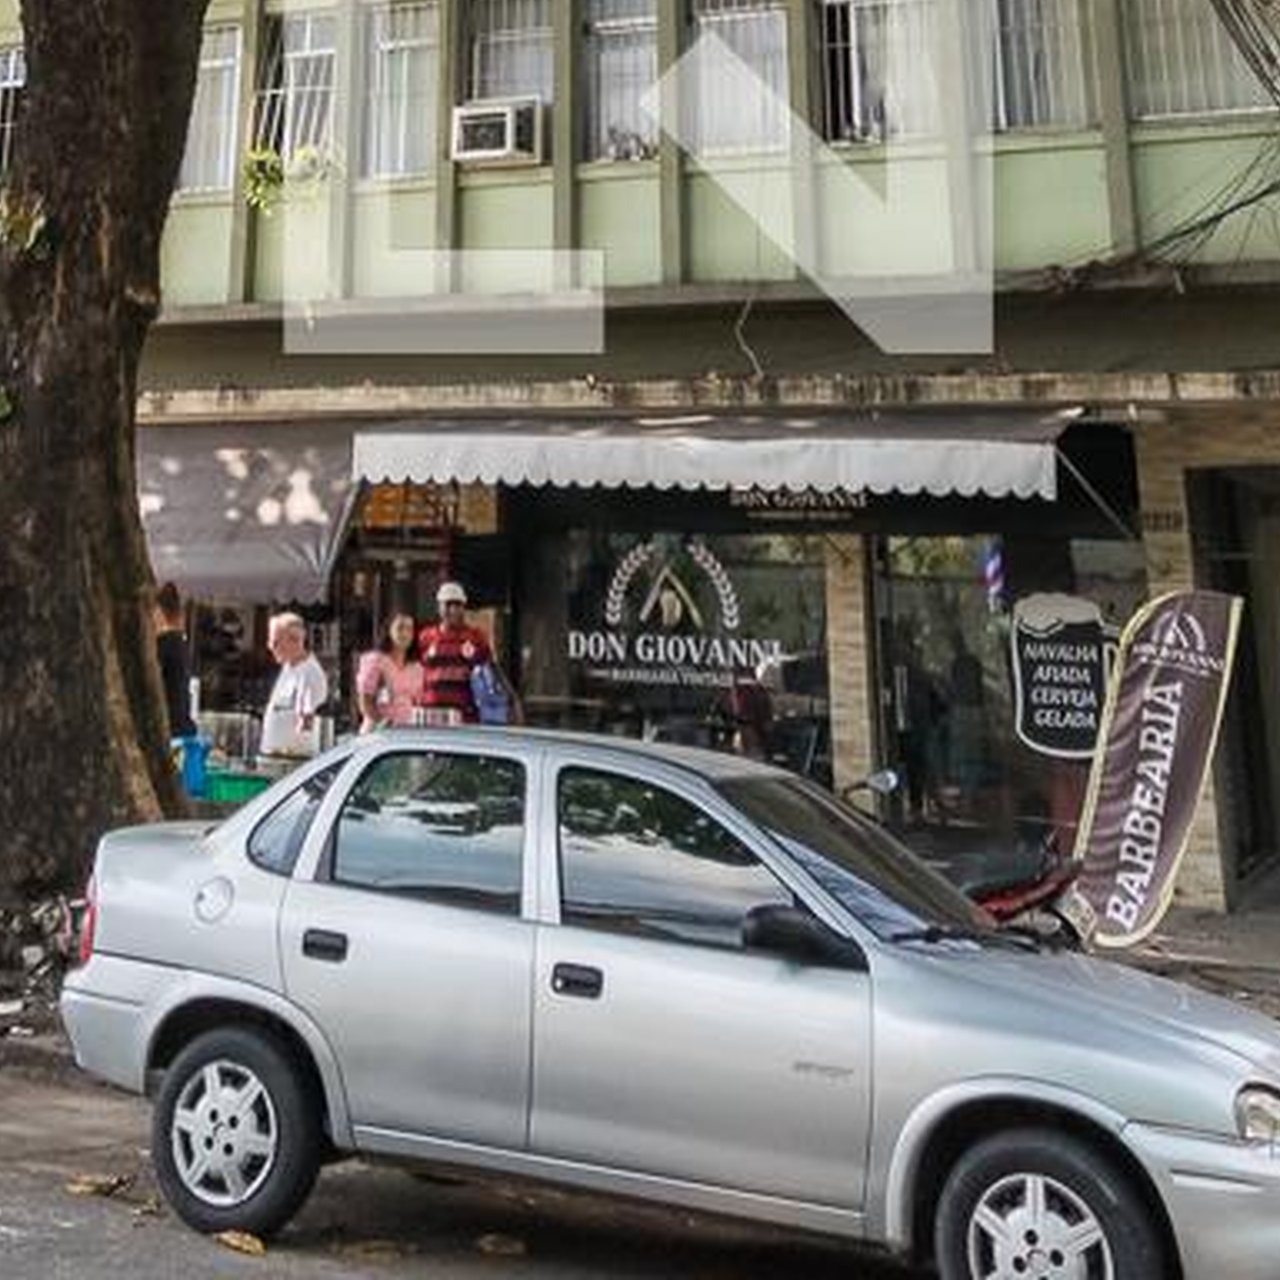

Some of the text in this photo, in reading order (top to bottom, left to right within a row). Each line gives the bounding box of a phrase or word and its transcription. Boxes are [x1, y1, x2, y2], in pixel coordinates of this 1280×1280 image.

[568, 631, 783, 669] DON GIOVANNI
[1023, 642, 1099, 662] NAVALHA
[1032, 666, 1091, 684] AFIADA
[1030, 687, 1098, 708] CERVEJA
[1033, 709, 1097, 729] GELADA
[1106, 680, 1184, 930] BARBEARIA
